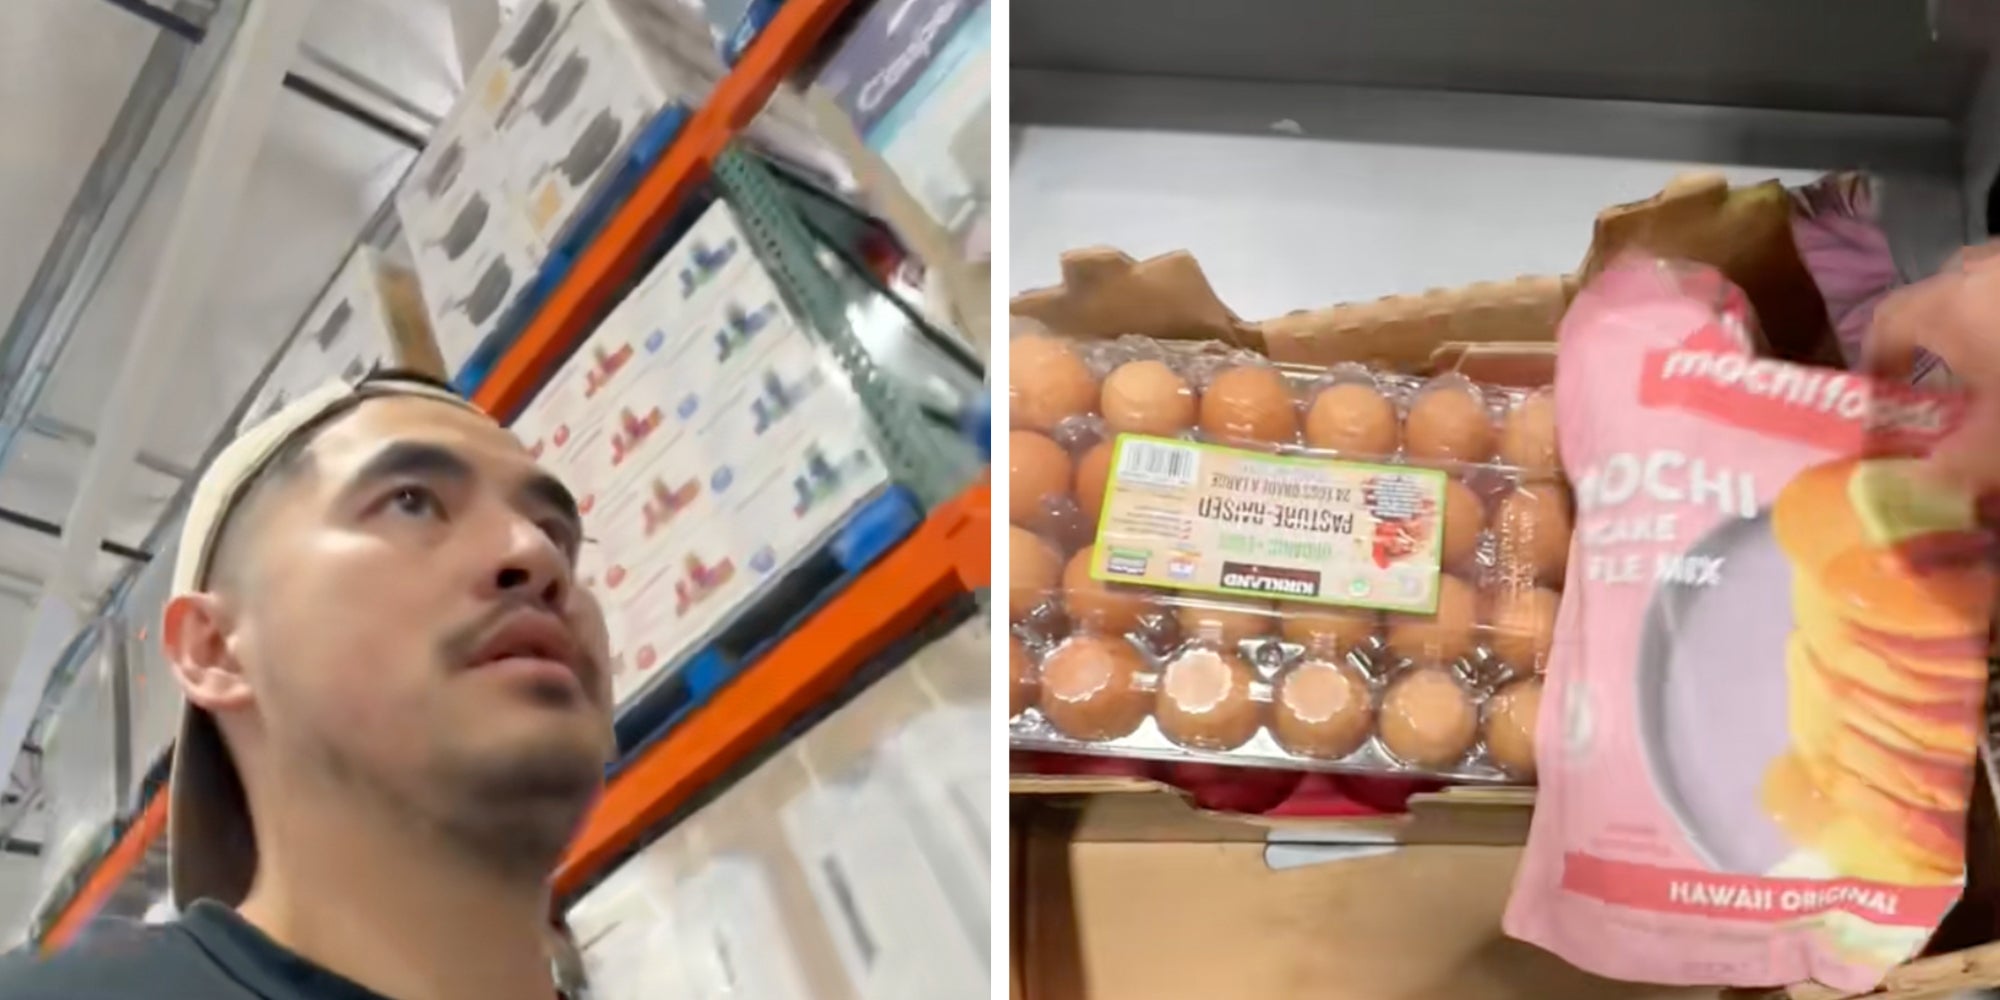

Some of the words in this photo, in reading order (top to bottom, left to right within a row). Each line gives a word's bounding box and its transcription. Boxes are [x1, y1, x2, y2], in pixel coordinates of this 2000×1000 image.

[1198, 496, 1354, 534] PASTURE-RAISED
[1224, 573, 1316, 594] KIRKLAND
[1655, 555, 1725, 585] MIX
[1669, 881, 1772, 910] HAWAII
[1781, 884, 1898, 914] ORIGINAL
